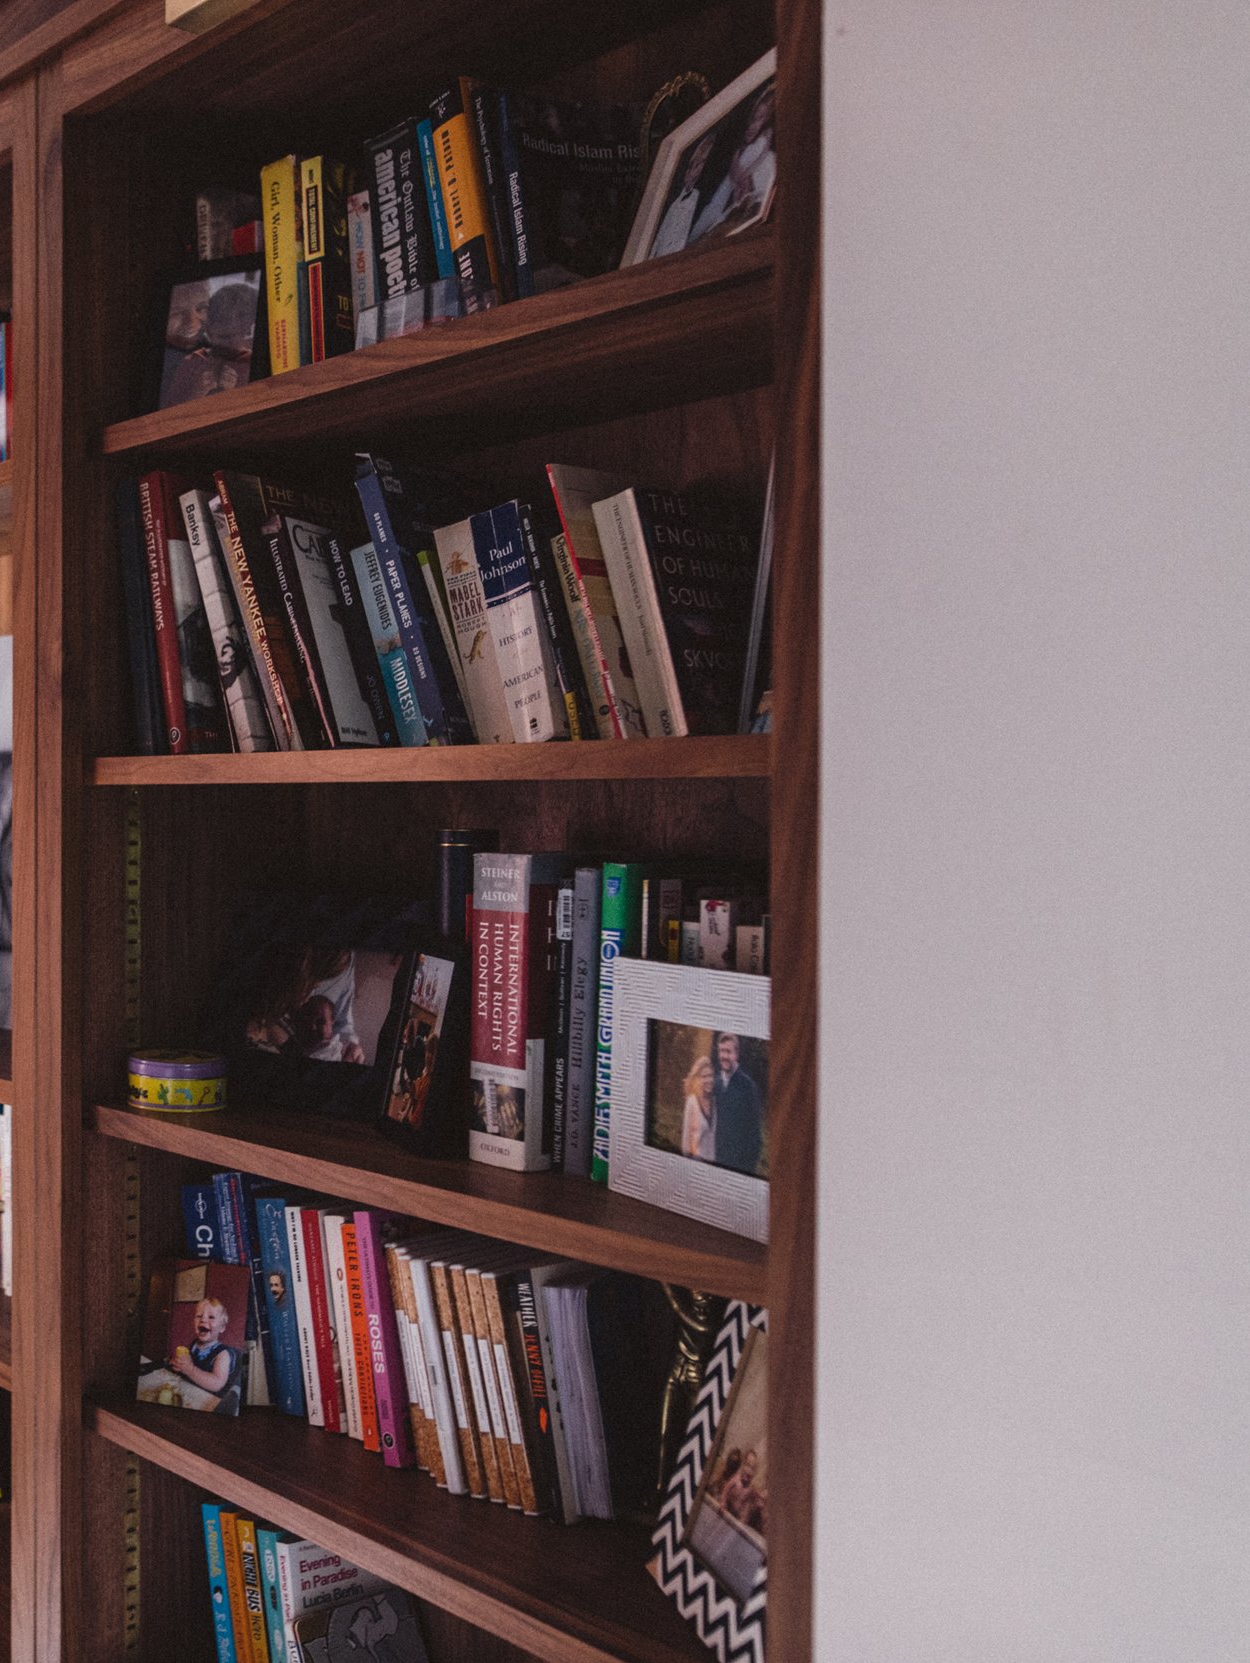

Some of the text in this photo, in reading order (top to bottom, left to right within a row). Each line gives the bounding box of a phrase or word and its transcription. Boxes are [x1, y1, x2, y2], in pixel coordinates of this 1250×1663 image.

[398, 148, 411, 177] The
[522, 133, 640, 159] Radical Islam Ris
[373, 148, 401, 247] american
[401, 180, 415, 232] Outlaw
[509, 171, 527, 266] Radical Islam Rising
[270, 181, 281, 302] Girl, Woman, Other
[405, 233, 417, 273] Bible
[356, 250, 366, 273] NOT
[139, 482, 152, 529] BRITISH
[265, 485, 294, 501] THE
[648, 494, 688, 516] THE
[185, 503, 201, 546] Banksy
[225, 510, 238, 533] THE
[654, 525, 750, 552] ENGINEER
[145, 531, 156, 568] STEAM
[230, 535, 250, 575] NEW
[269, 537, 289, 591] ILLUSTRATED
[480, 553, 526, 582] Johnson
[488, 542, 514, 562] Paul
[662, 556, 686, 575] OF
[328, 539, 354, 606] HOW TO LEAD
[554, 535, 581, 603] Virginia Woolf
[150, 572, 164, 631] RAILWAYS
[239, 574, 267, 640] YANKEE
[363, 550, 392, 630] JEFFREY EUGENIDES
[374, 520, 427, 679] PLANES PAPER PLANES DESIGNS
[449, 582, 481, 604] MABEL
[452, 597, 484, 620] STARK
[668, 586, 724, 609] SOULS
[457, 616, 485, 628] ROBERT
[458, 622, 487, 634] HOUGH
[498, 625, 536, 648] HISTORY
[258, 638, 283, 704] WORKSHOP
[388, 656, 417, 724] MIDDLESEX
[502, 665, 544, 690] AMERICAN
[514, 690, 542, 709] PEOPLE
[481, 868, 520, 880] STEINER
[481, 891, 518, 902] ALSTON
[477, 921, 488, 1019] IN CONTEXT
[491, 923, 503, 1051] HUMAN RIGHTS
[506, 923, 519, 1055] INTERNATIONAL
[596, 929, 619, 1045] GRAND UNION
[571, 956, 587, 1068] Hillbilly Elegy
[552, 1057, 564, 1162] WHEN CRIME APPEARS
[571, 1083, 580, 1123] VANCE
[593, 1051, 611, 1160] ZADIE SMITH
[480, 1143, 510, 1156] OXFORD
[194, 1224, 215, 1257] Ch
[346, 1231, 359, 1271] PETER
[350, 1277, 363, 1318] IRONS
[367, 1312, 385, 1374] ROSES
[357, 1360, 368, 1416] CONVICTIONS
[242, 1551, 257, 1586] NIGHT
[278, 1554, 289, 1591] Evening
[300, 1554, 341, 1573] Evening
[301, 1566, 358, 1590] in Paradise
[246, 1586, 261, 1612] BUS
[303, 1584, 364, 1608] Lucia Berlin
